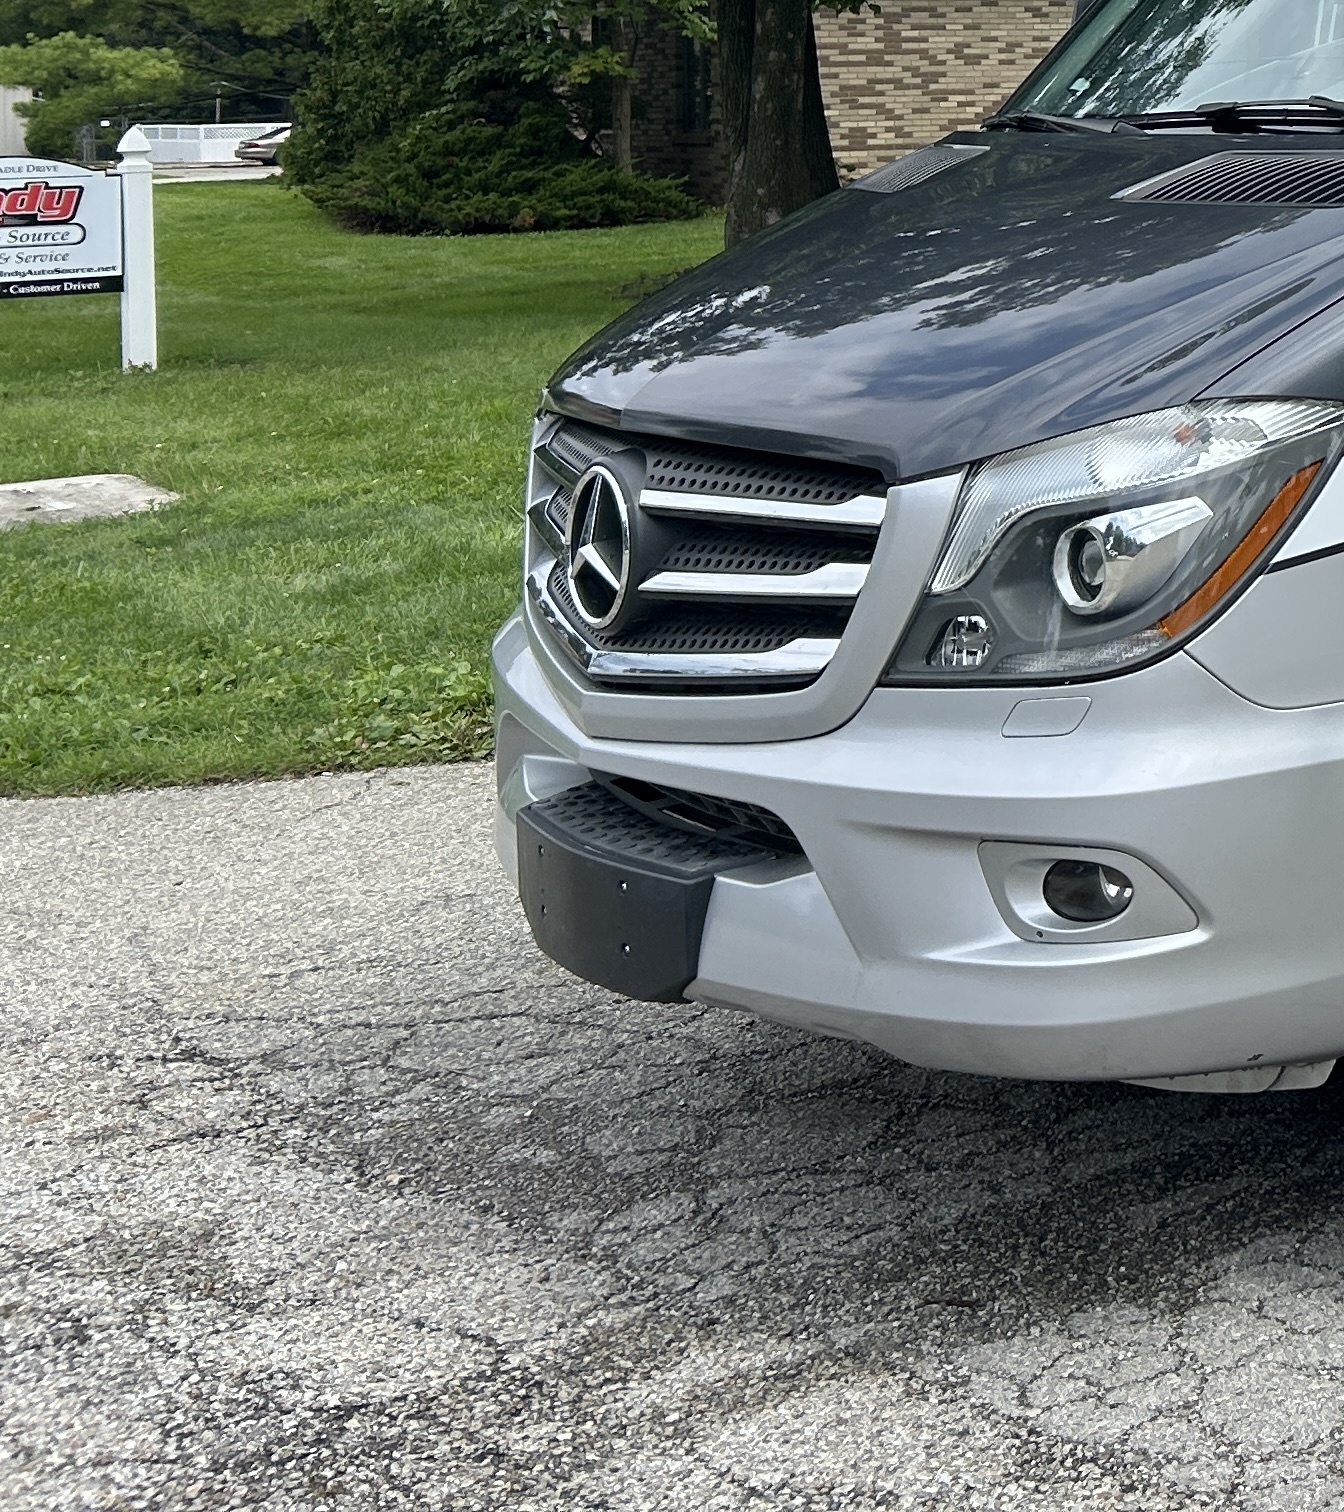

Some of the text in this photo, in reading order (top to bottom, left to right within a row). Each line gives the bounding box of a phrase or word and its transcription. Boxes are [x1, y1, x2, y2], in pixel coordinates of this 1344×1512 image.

[26, 164, 59, 173] DRIVE
[7, 229, 71, 244] Source
[15, 250, 70, 264] Service
[10, 284, 61, 295] Customer
[63, 281, 101, 292] Driven
